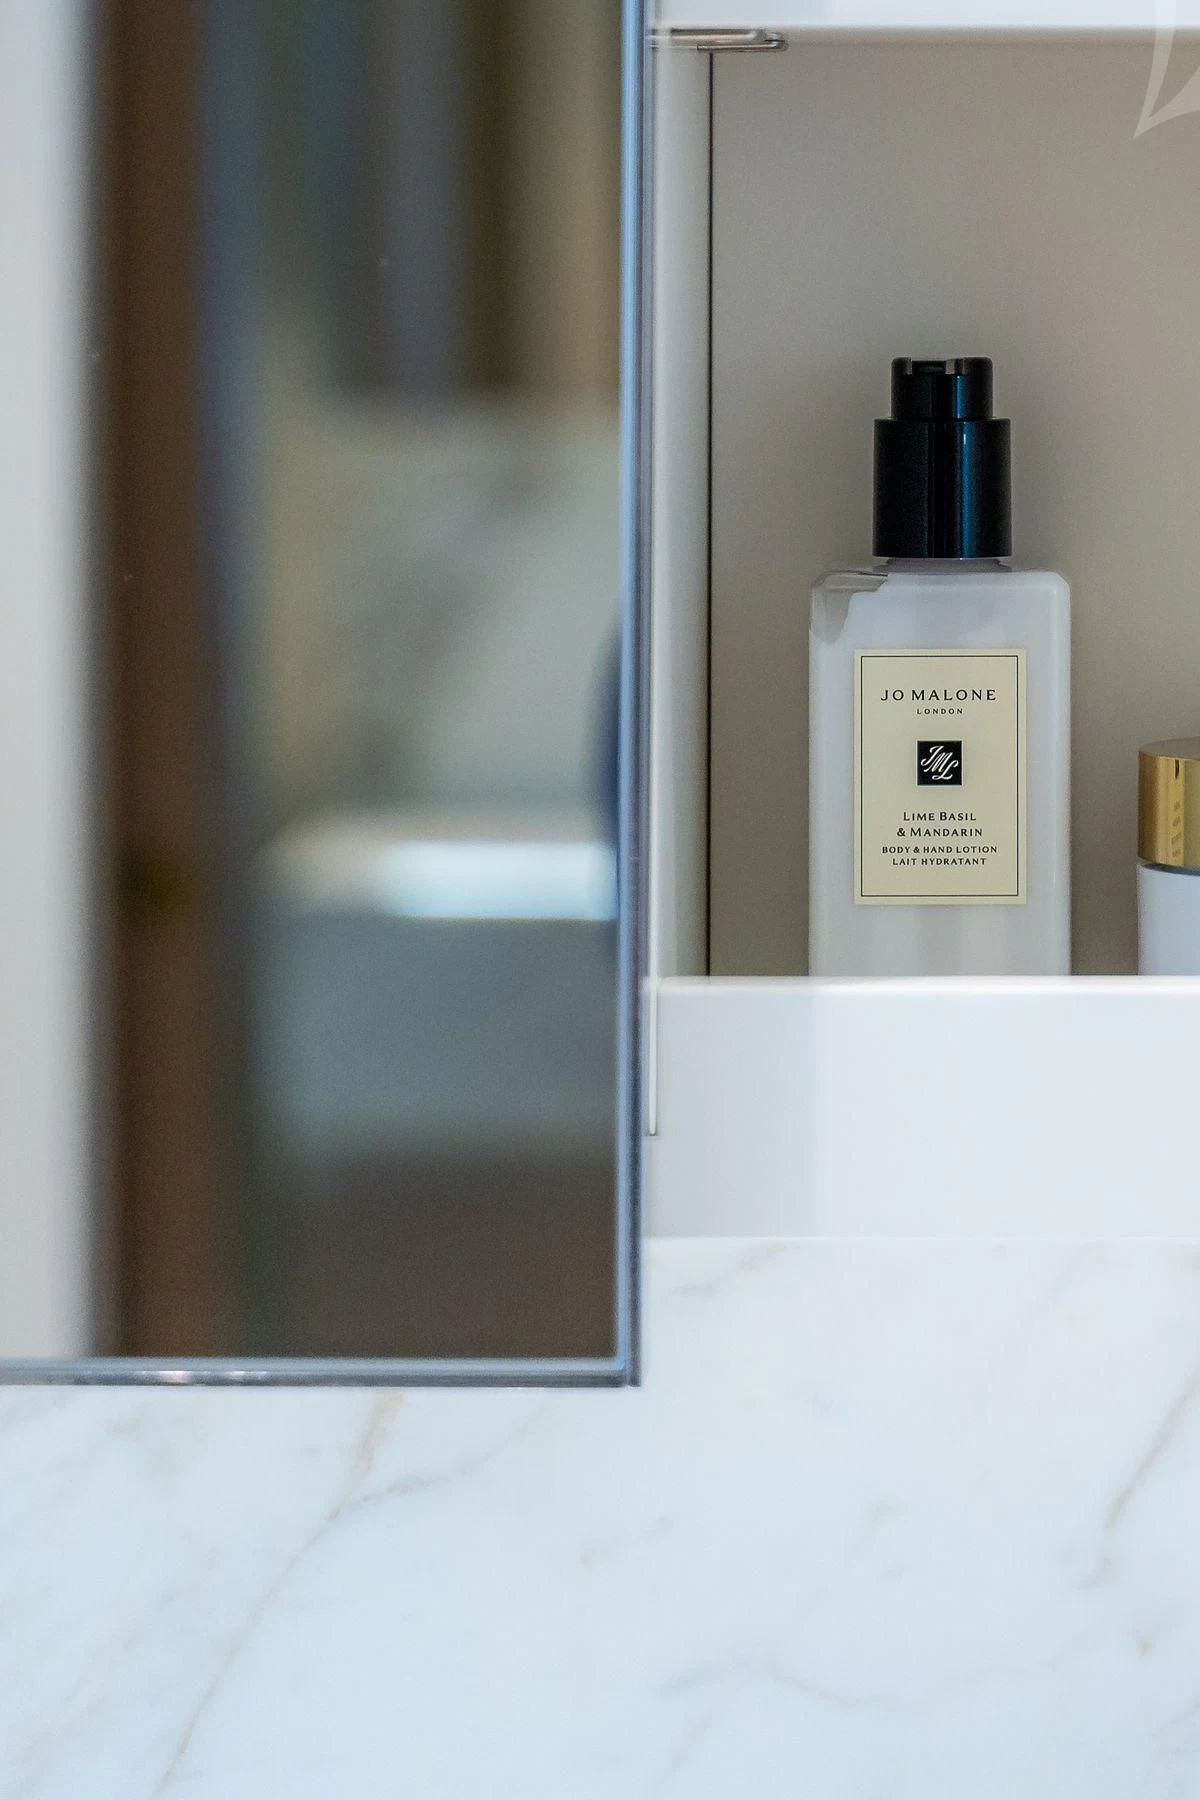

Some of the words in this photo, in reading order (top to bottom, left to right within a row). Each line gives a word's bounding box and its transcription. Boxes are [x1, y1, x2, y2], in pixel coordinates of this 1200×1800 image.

[880, 689, 905, 702] JO
[911, 688, 997, 702] MALONE
[916, 707, 963, 715] LONDON
[903, 811, 936, 822] LIME
[939, 811, 977, 822] BASIL
[896, 827, 906, 838] &
[909, 826, 983, 838] MANDARIN
[881, 845, 911, 854] BODY
[912, 845, 921, 854] &
[922, 845, 953, 854] HAND
[955, 845, 998, 854] LOTION
[892, 857, 918, 866] LAIT
[920, 857, 987, 866] HYDRATANT
